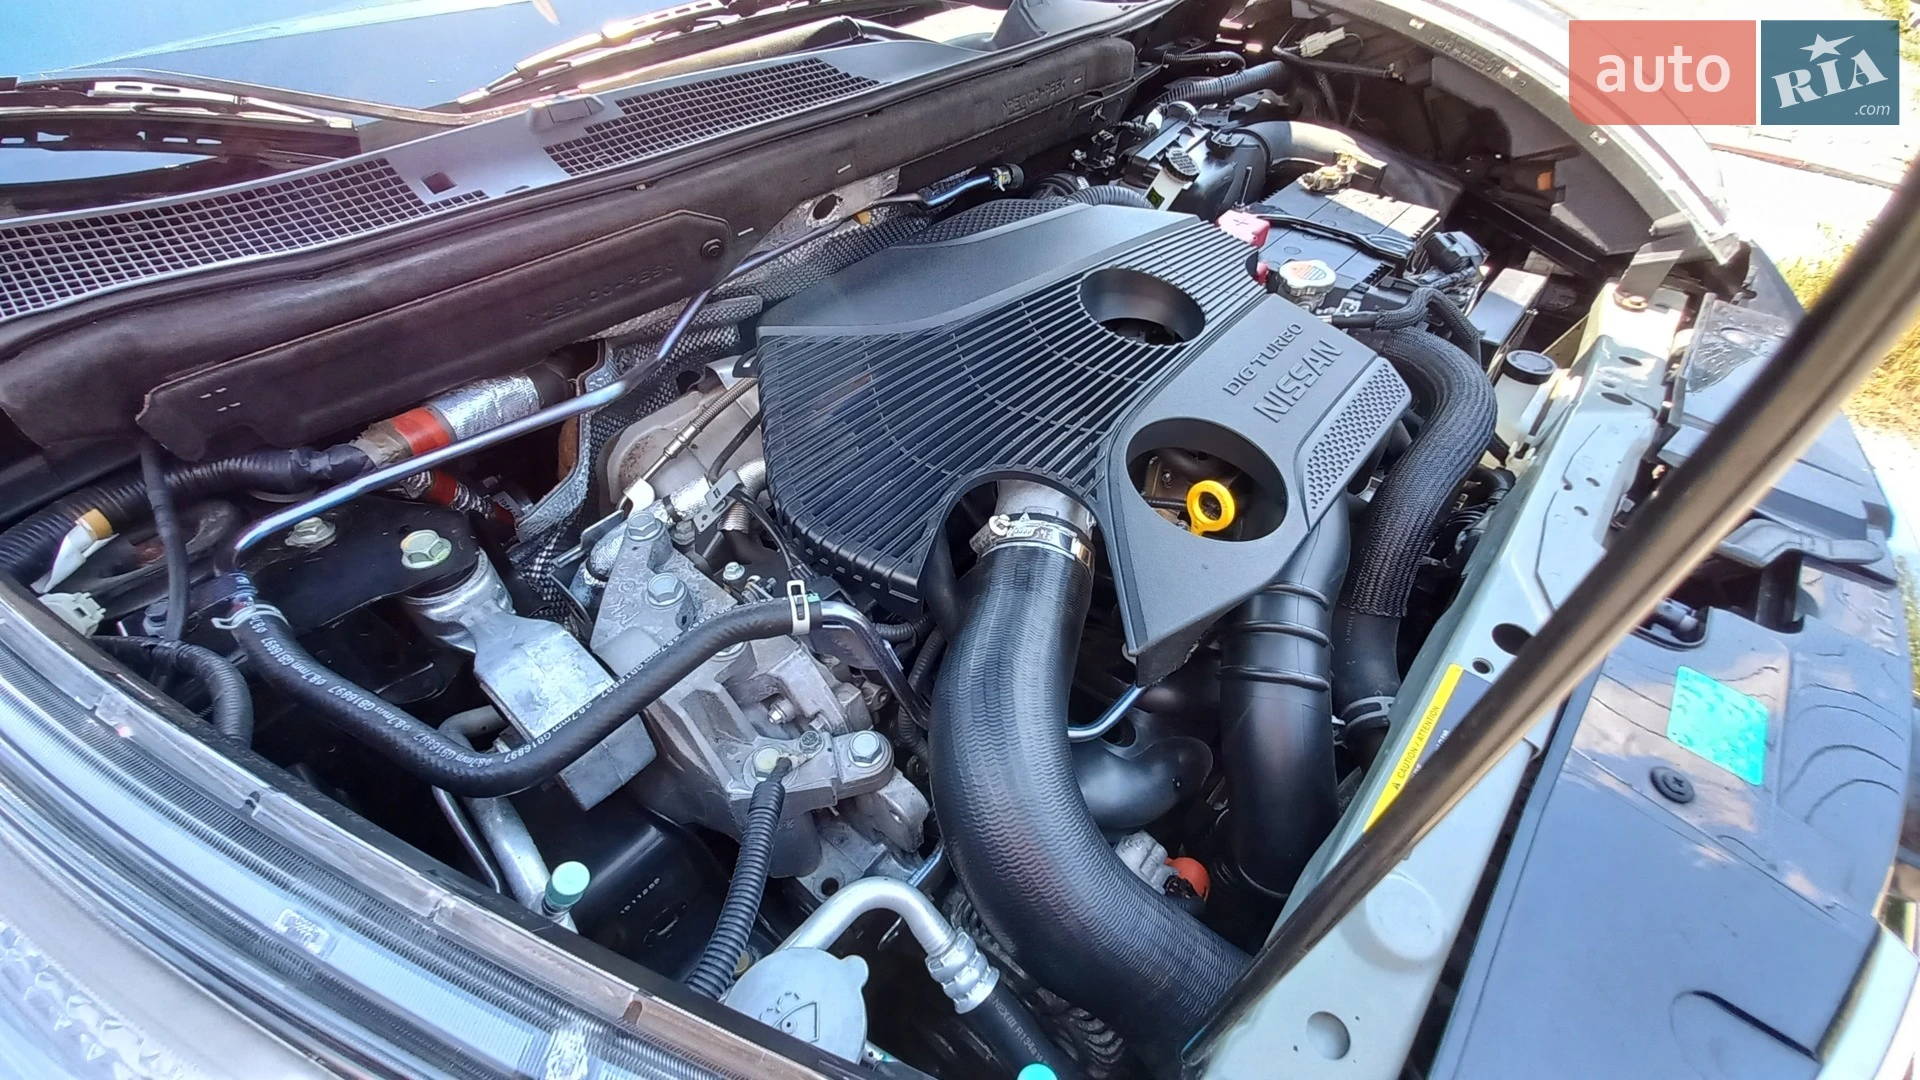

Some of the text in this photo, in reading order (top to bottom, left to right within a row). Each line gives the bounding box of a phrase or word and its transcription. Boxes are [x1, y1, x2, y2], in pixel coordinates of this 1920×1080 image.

[1222, 322, 1304, 396] DIG TURBO
[1253, 340, 1342, 423] NISSAN
[1396, 745, 1418, 779] CAUTION
[1417, 705, 1440, 742] ATTENTION
